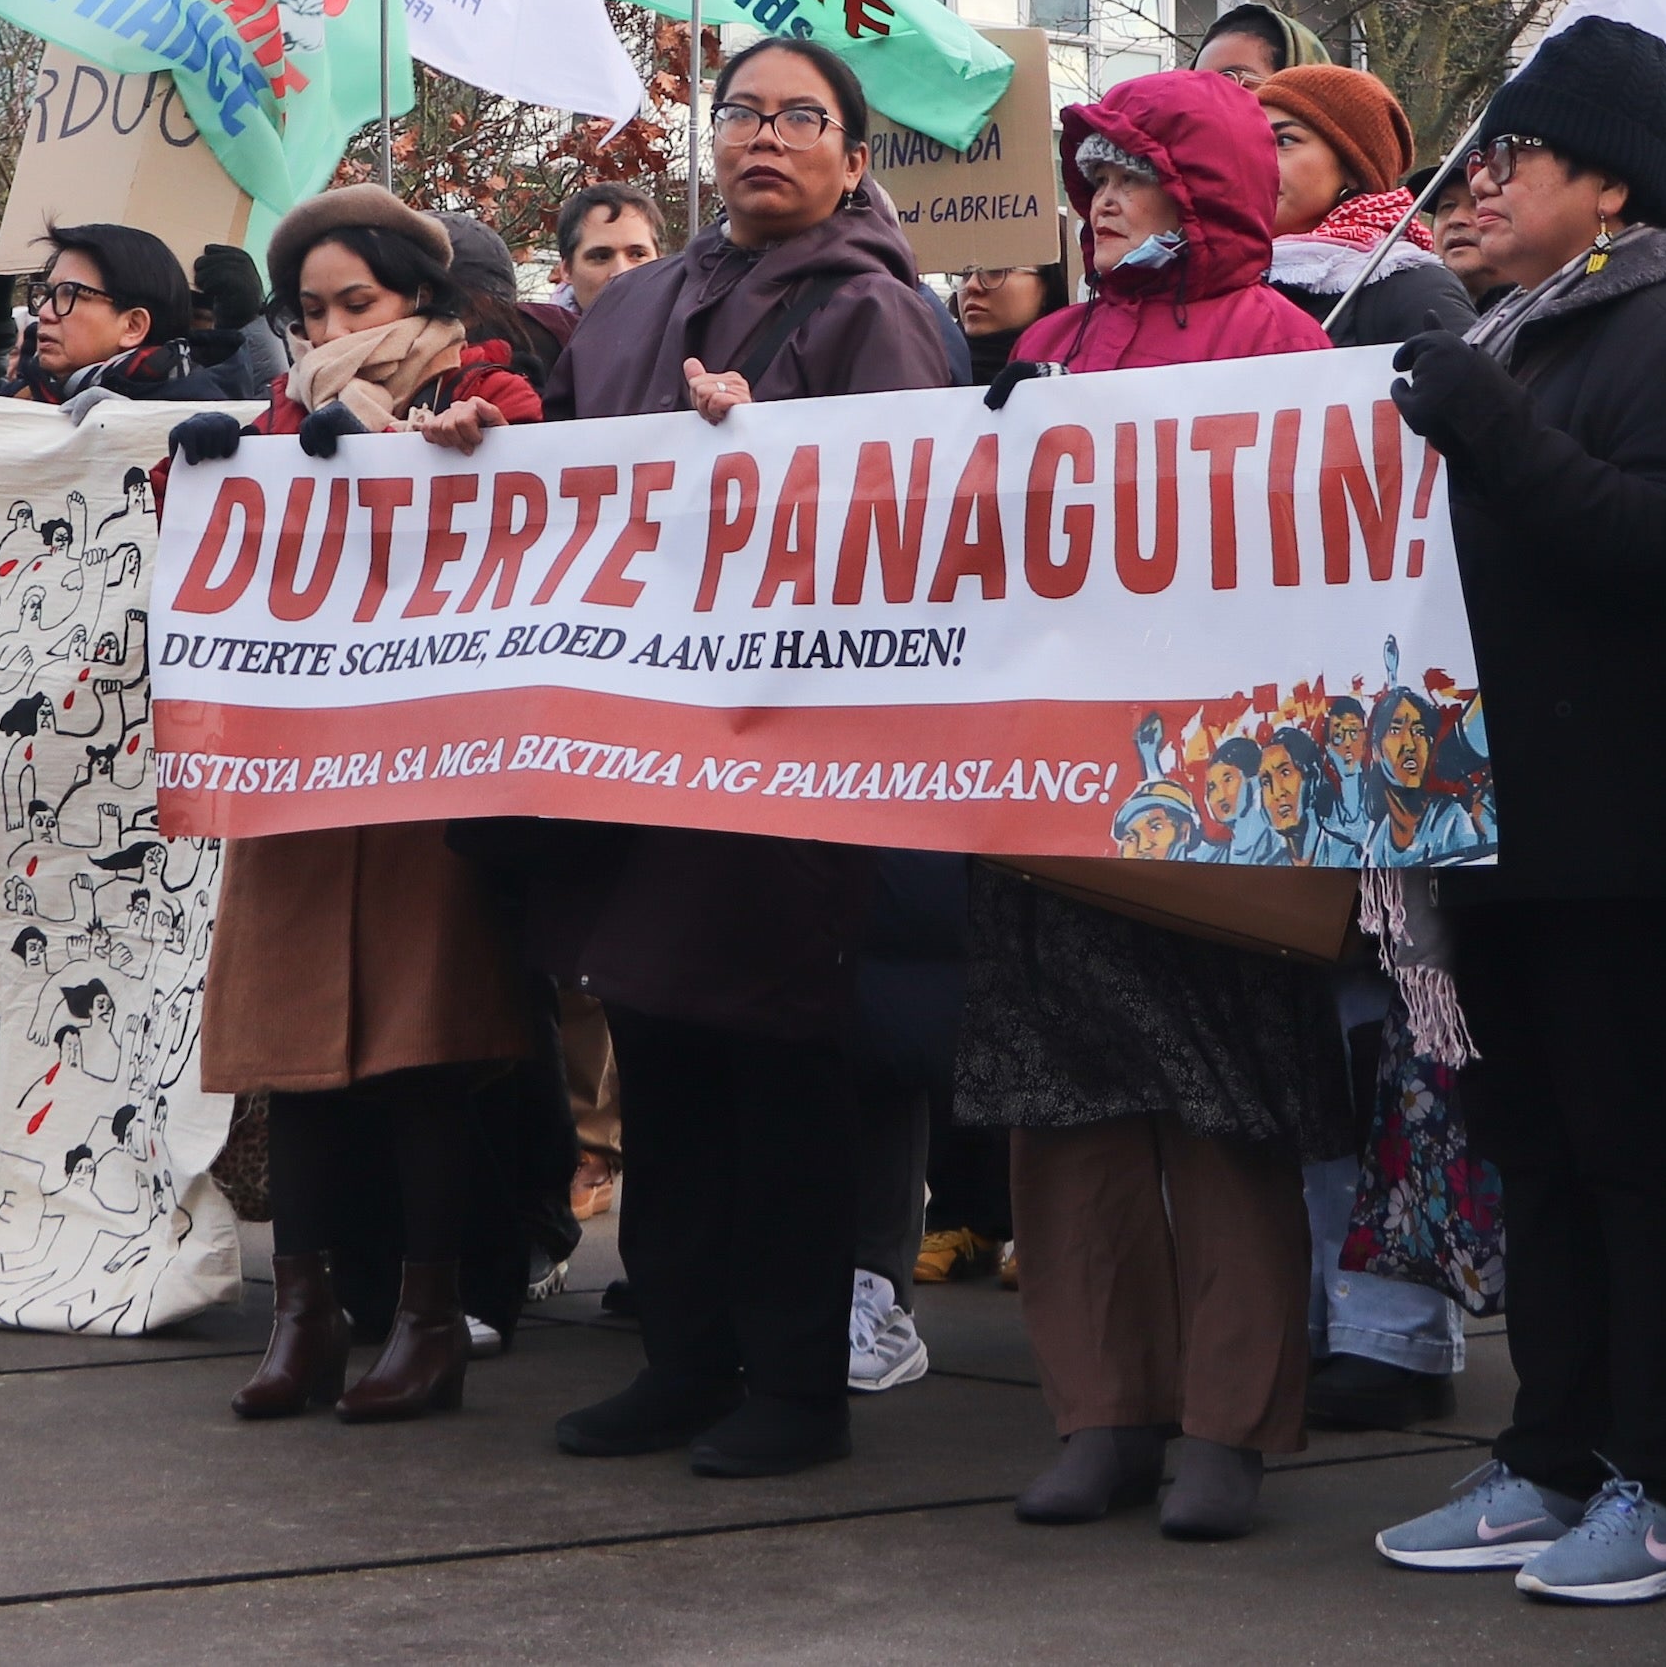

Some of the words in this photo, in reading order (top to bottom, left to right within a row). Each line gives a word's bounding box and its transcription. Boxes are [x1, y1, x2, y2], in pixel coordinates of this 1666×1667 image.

[930, 194, 1038, 223] GABRIELA
[170, 460, 676, 624] DUTERTE
[693, 399, 1446, 615] PANAGUTIN!
[159, 633, 337, 676] DUTERTE
[338, 629, 492, 677] SCHANDE,
[496, 621, 627, 661] BLOED
[629, 632, 726, 672] AAN
[725, 631, 766, 672] JE
[771, 627, 966, 672] HANDEN!
[154, 751, 299, 794] HUSTISYA
[307, 748, 383, 791] PARA
[386, 744, 428, 784] SA
[431, 736, 507, 779] MGA
[507, 733, 683, 788] BIKTIMA
[685, 756, 762, 797] NG
[761, 758, 1118, 805] PAMAMASLANG!
